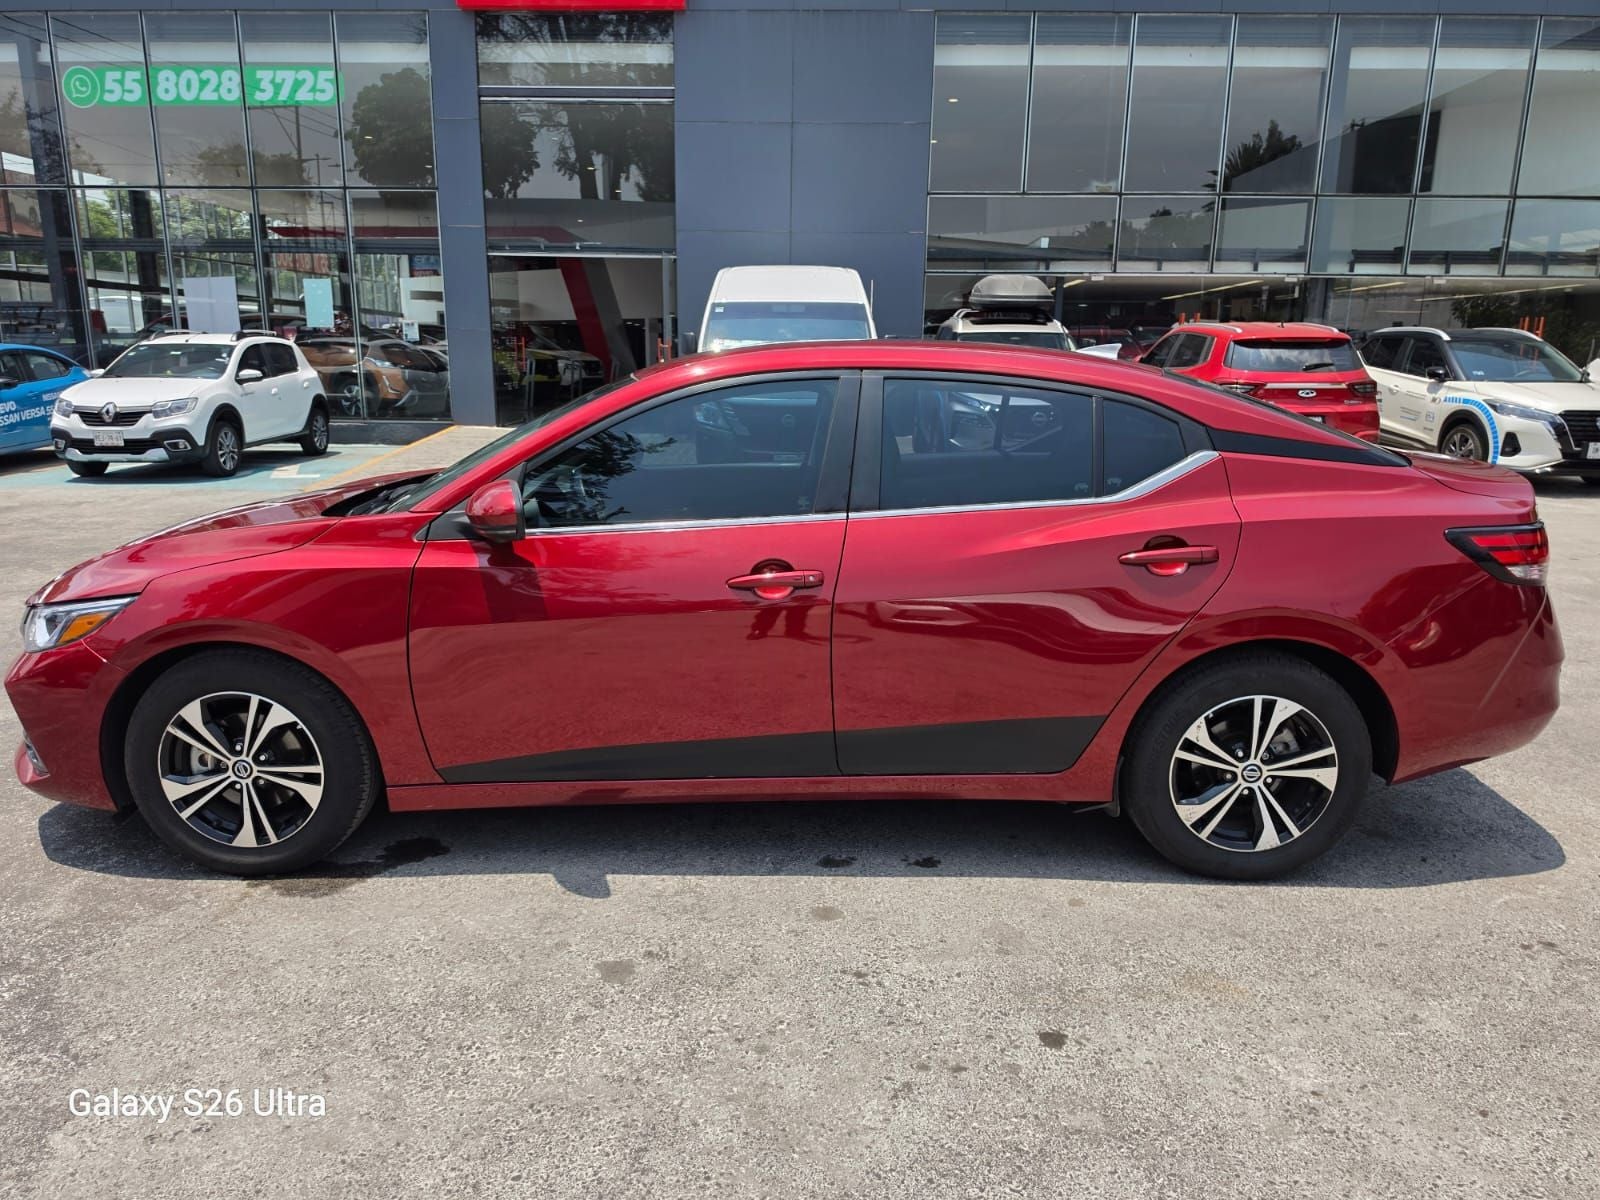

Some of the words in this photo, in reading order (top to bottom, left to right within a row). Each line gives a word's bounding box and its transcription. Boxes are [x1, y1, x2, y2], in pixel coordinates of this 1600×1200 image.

[104, 71, 142, 102] 55
[156, 69, 240, 102] 8028
[254, 69, 334, 102] 3725
[20, 406, 46, 421] VERSA
